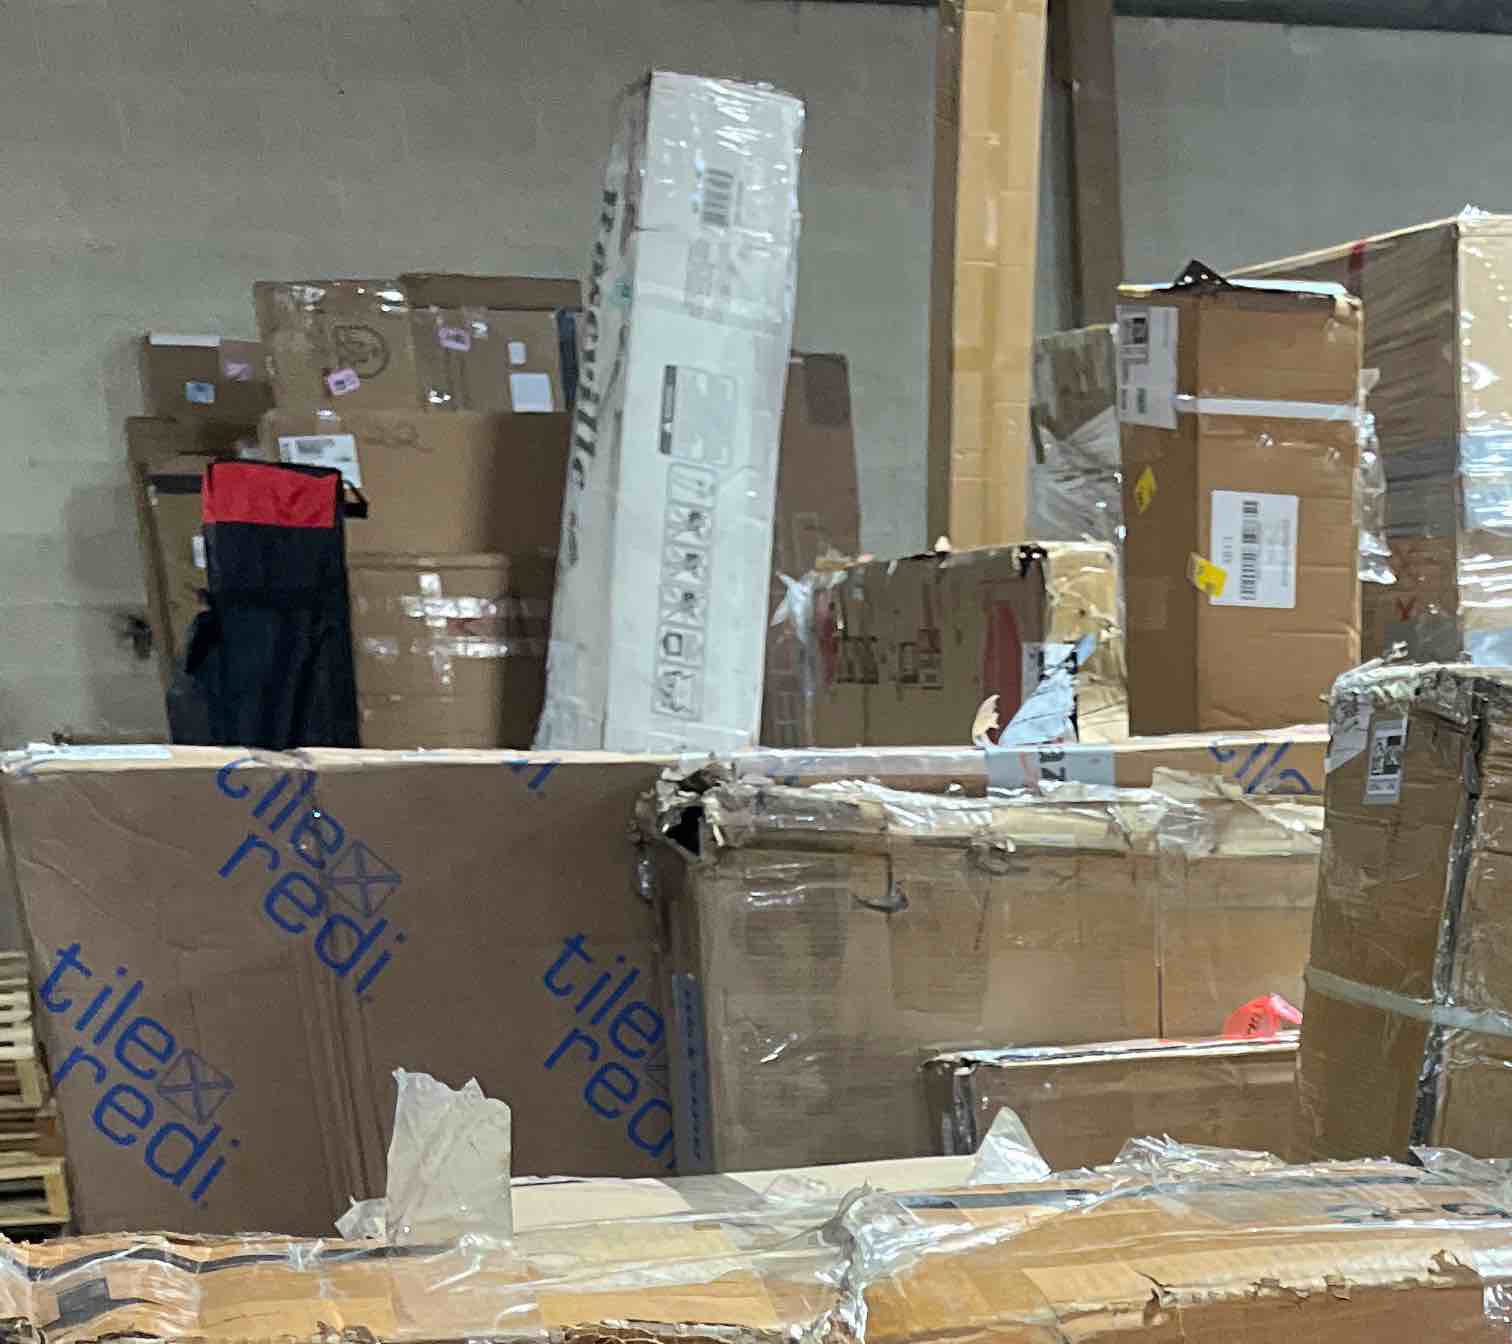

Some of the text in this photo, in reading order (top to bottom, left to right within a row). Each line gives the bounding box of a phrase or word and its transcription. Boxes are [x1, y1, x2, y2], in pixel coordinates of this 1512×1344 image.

[217, 834, 406, 993] redi
[38, 943, 174, 1078] tile
[544, 933, 664, 1060] tile
[54, 1046, 240, 1201] redi
